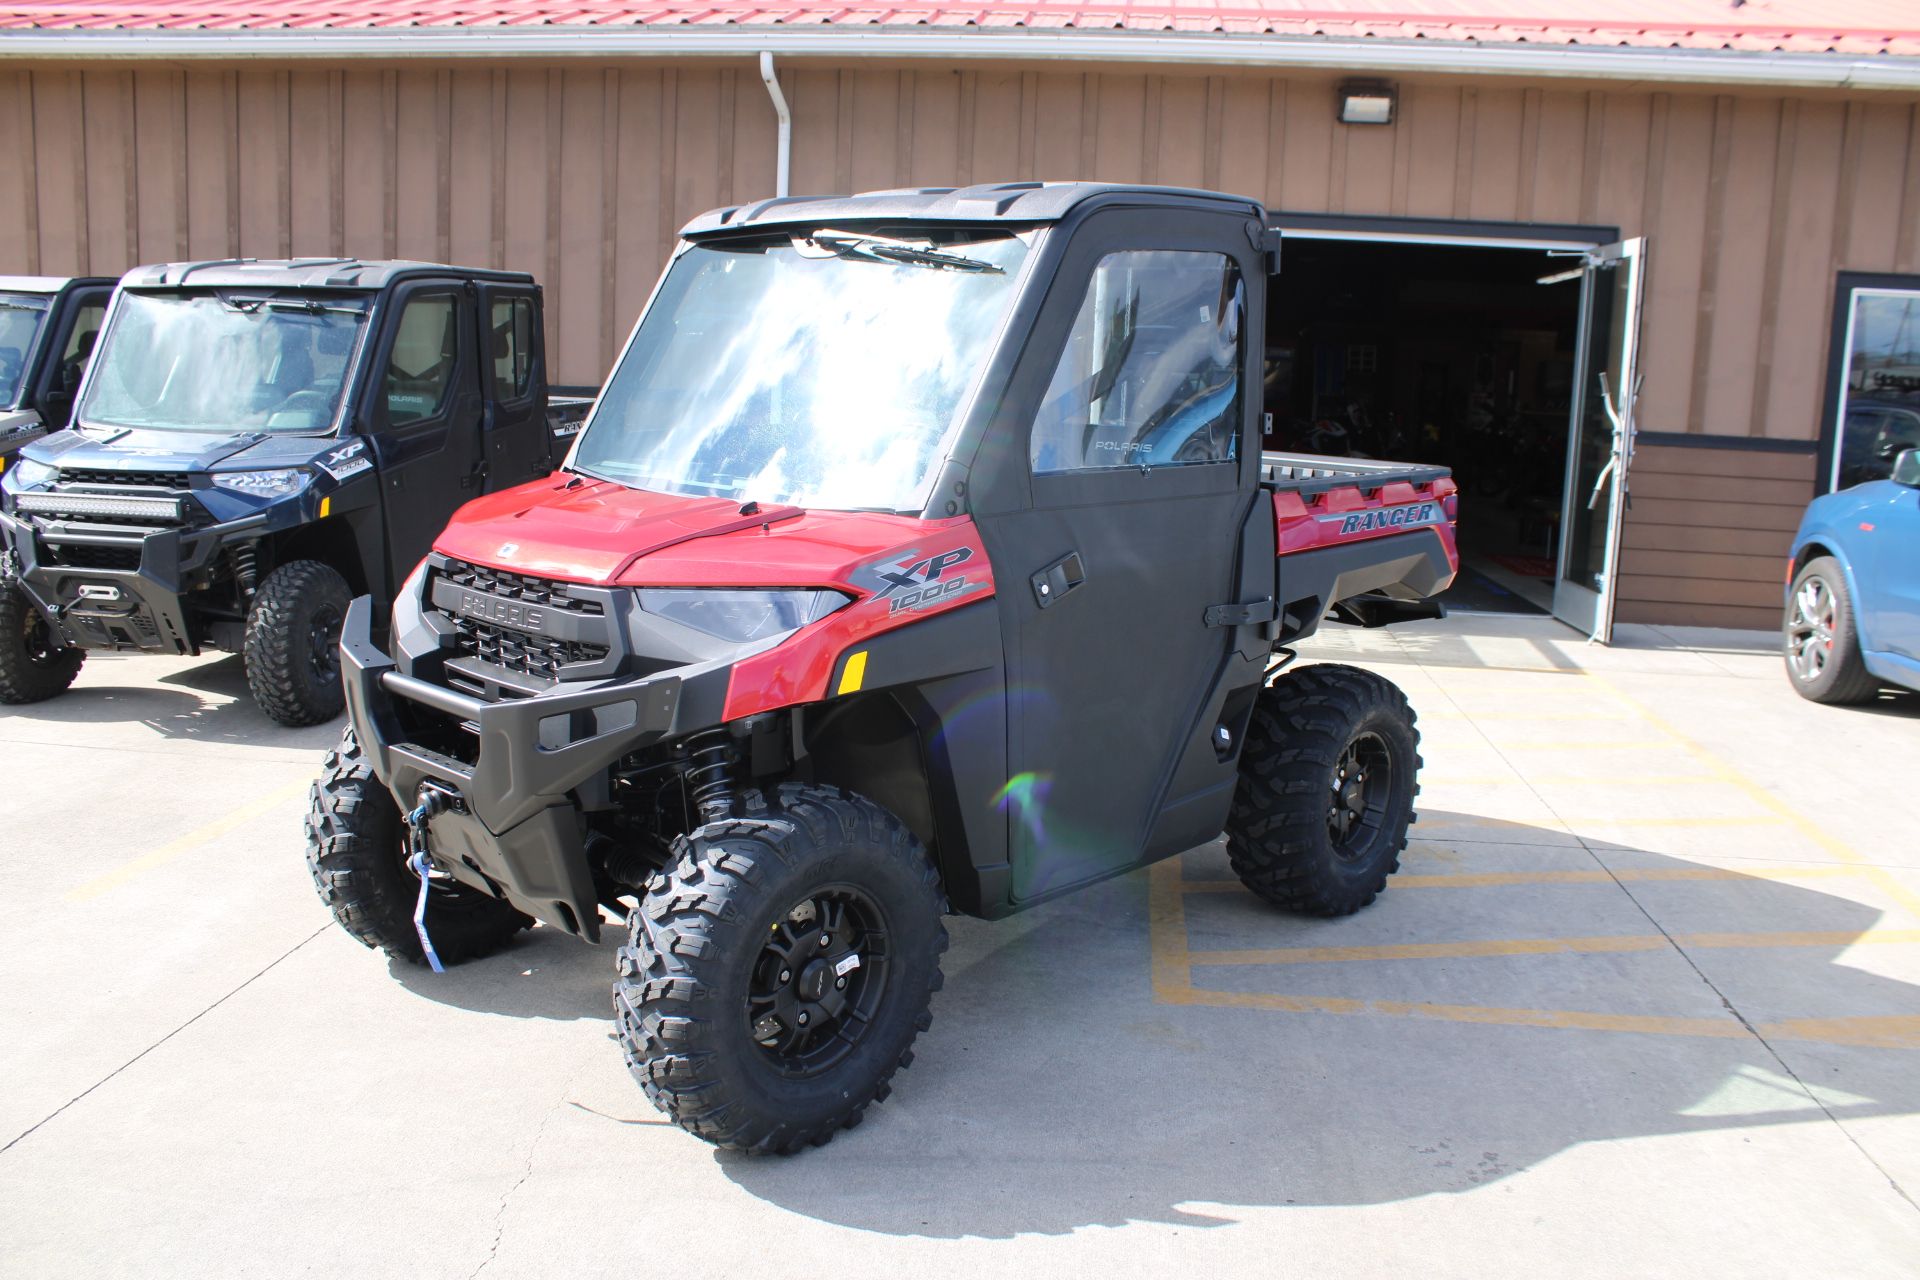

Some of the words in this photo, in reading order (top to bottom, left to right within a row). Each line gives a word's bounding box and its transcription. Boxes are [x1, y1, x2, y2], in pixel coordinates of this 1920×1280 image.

[328, 442, 364, 466] XP
[1095, 441, 1153, 452] POLARIS
[1340, 503, 1433, 535] RANGER
[863, 545, 975, 606] XP
[889, 576, 966, 614] 1000
[461, 594, 544, 631] POLARIS
